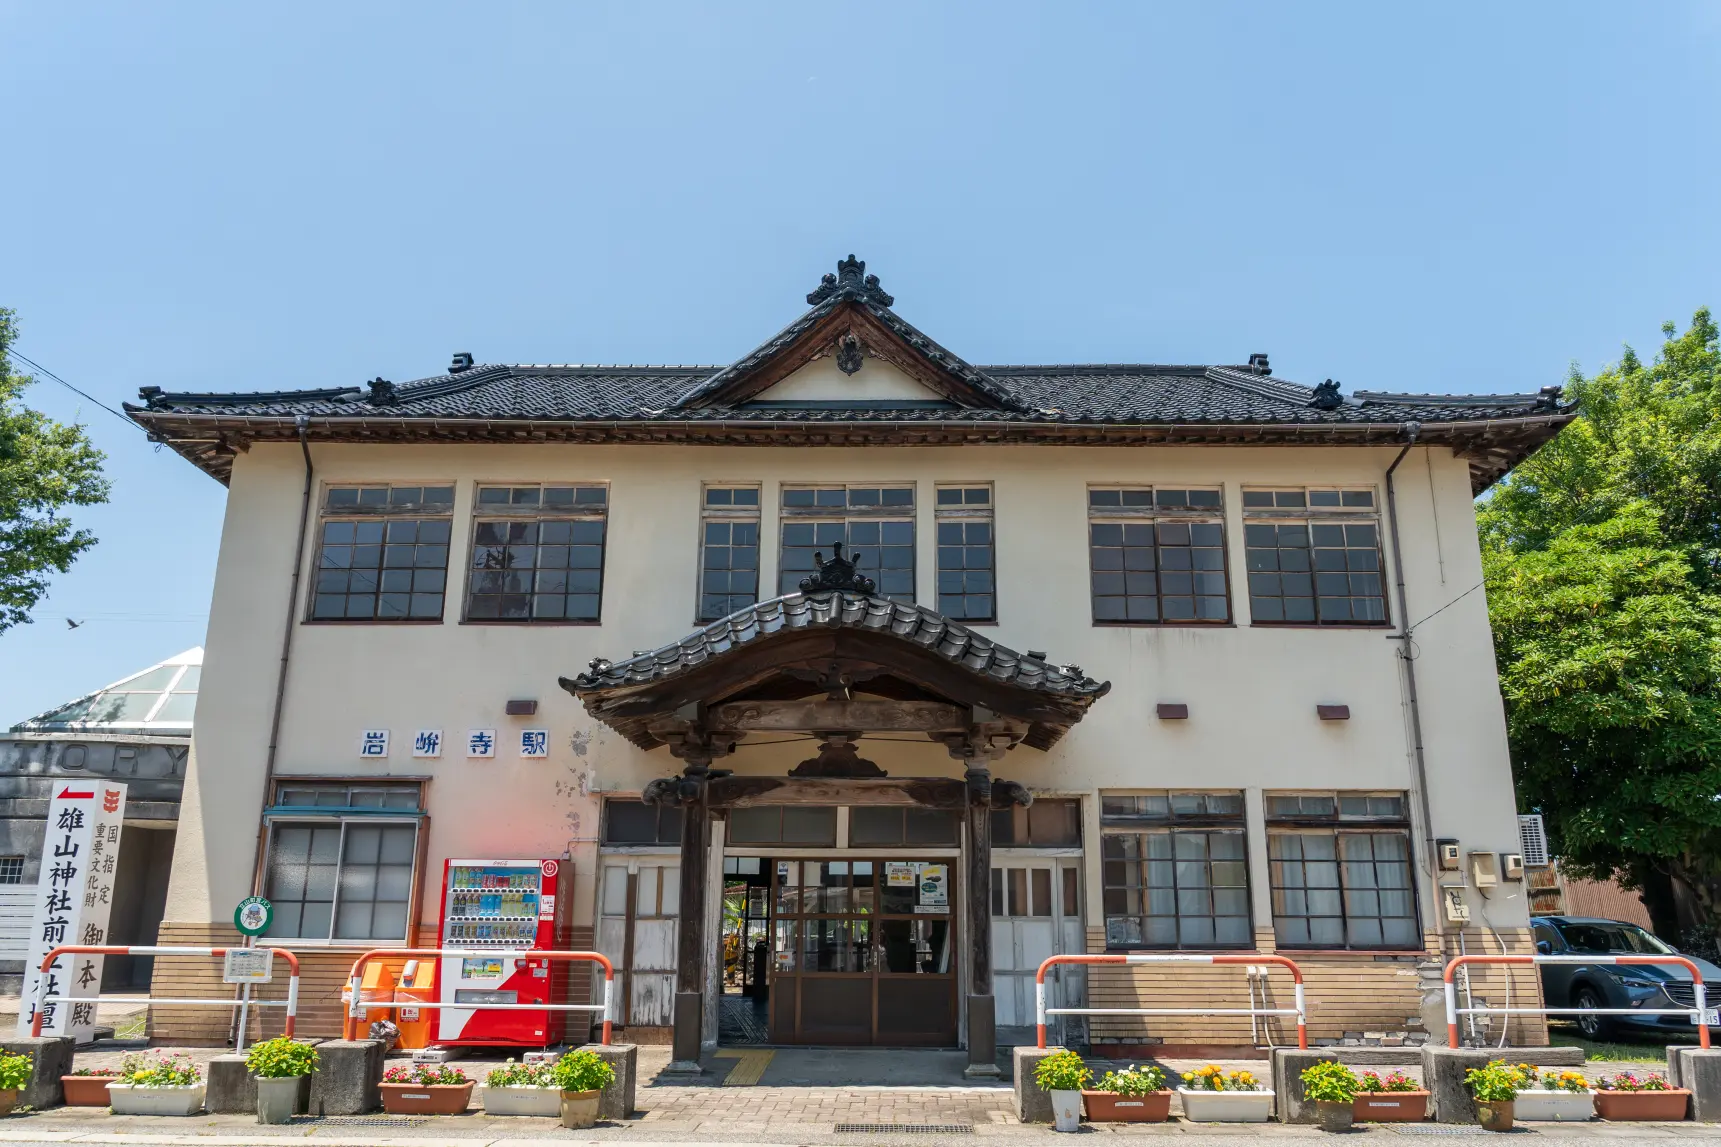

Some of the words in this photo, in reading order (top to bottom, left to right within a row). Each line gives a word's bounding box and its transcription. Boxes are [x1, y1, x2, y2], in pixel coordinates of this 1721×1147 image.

[84, 823, 106, 908] 重要文化財
[98, 825, 119, 904] 国指定
[71, 923, 104, 1027] 御本殿
